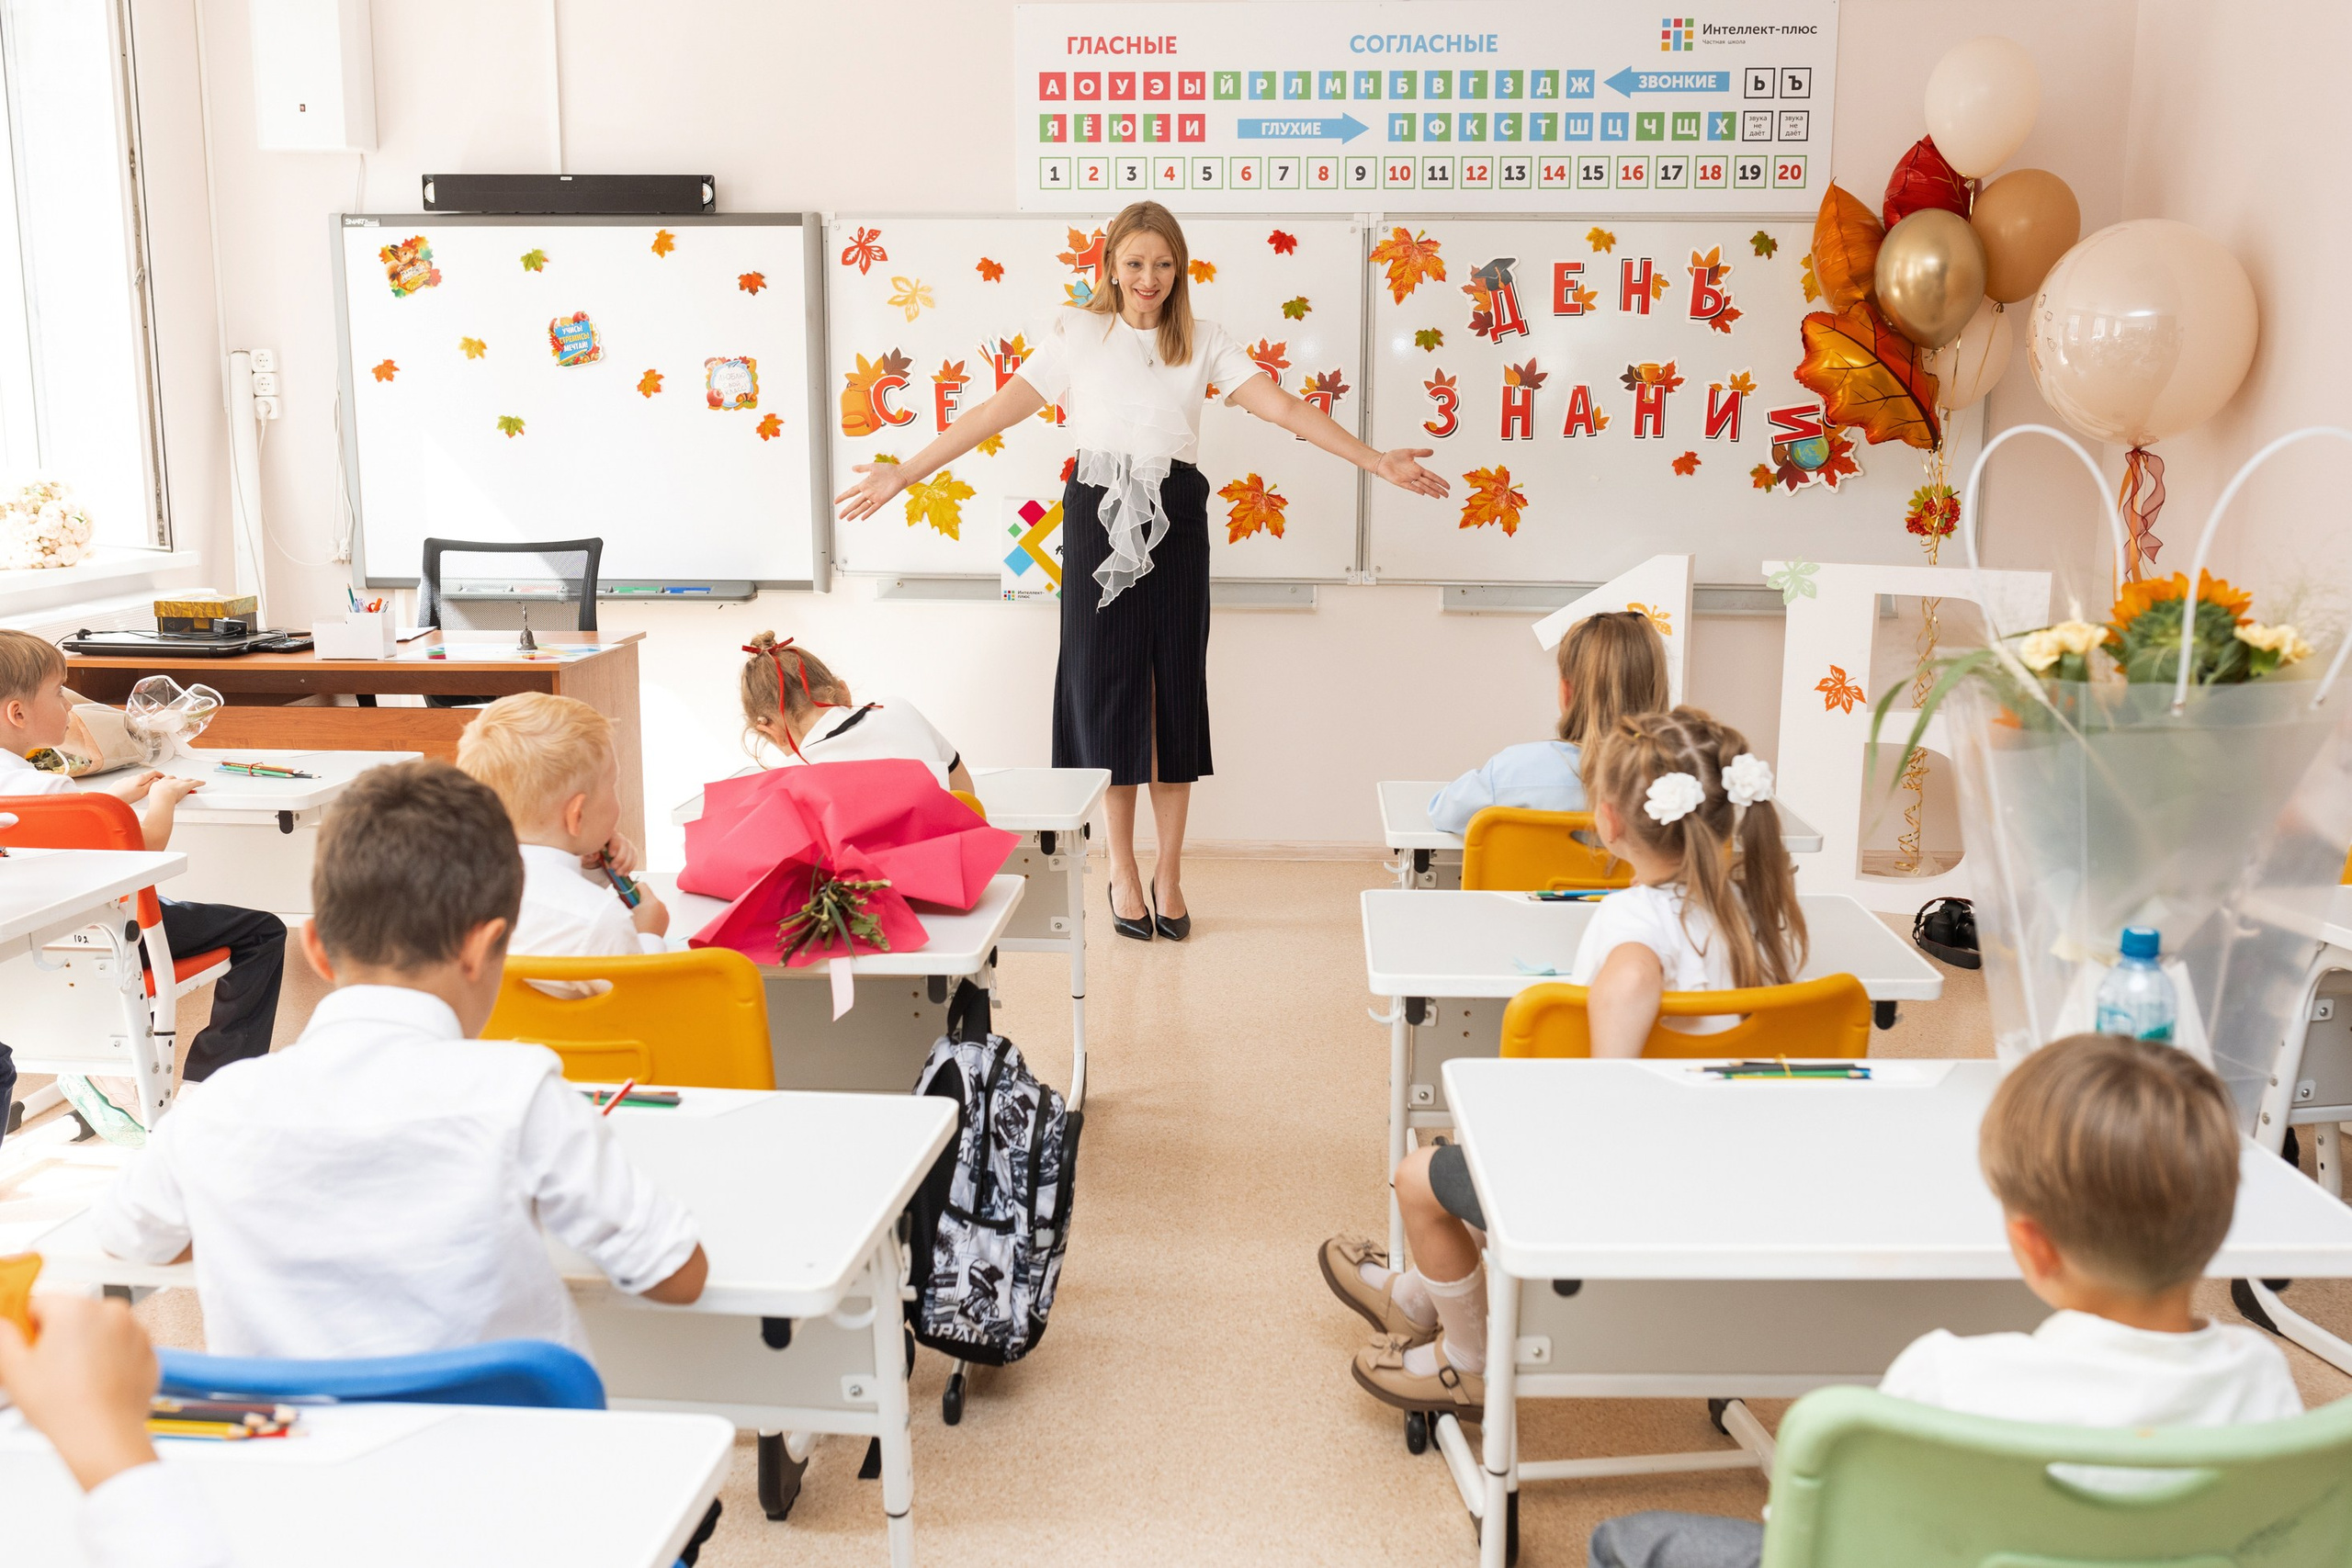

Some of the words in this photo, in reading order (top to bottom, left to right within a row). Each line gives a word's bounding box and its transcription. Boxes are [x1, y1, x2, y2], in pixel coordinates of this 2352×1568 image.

[1702, 23, 1818, 35] Интеллект-плюс
[1068, 35, 1178, 55] ГЛАСНЫЕ
[1350, 34, 1498, 53] СОГЛАСНЫЕ
[1046, 79, 1059, 96] А
[1079, 79, 1095, 96] О
[1115, 79, 1129, 95] У
[1149, 78, 1164, 95] Э
[1184, 78, 1201, 95] Ы
[1220, 74, 1234, 95] Й
[1256, 78, 1268, 95] Р
[1288, 77, 1303, 95] Л
[1325, 77, 1341, 95] М
[1360, 77, 1374, 94] Н
[1396, 77, 1408, 94] Б
[1432, 77, 1444, 94] В
[1468, 77, 1478, 94] Г
[1502, 76, 1514, 94] З
[1536, 76, 1553, 96] Д
[1569, 76, 1590, 94] Ж
[1638, 74, 1716, 89] ЗВОНКИЕ
[1753, 74, 1766, 91] Ь
[1788, 74, 1803, 91] Ъ
[1046, 120, 1058, 137] Я
[1082, 117, 1093, 137] Ё
[1113, 120, 1134, 137] Ю
[1152, 120, 1162, 136] Е
[1185, 120, 1199, 136] И
[1261, 121, 1321, 136] ГЛУХИЕ
[1395, 119, 1408, 136] П
[1428, 118, 1446, 136] Ф
[1465, 119, 1478, 135] К
[1499, 118, 1514, 136] С
[1537, 118, 1550, 135] Т
[1569, 118, 1589, 135] Ш
[1608, 118, 1623, 138] Ц
[1644, 118, 1657, 134] Ч
[1677, 118, 1697, 137] Щ
[1715, 118, 1728, 134] Х
[1050, 166, 1060, 181] 1
[1089, 165, 1099, 181] 2
[1126, 166, 1137, 182] 3
[1163, 165, 1176, 181] 4
[1202, 165, 1213, 182] 5
[1240, 165, 1252, 182] 6
[1278, 165, 1289, 181] 7
[1317, 165, 1329, 182] 8
[1354, 165, 1366, 181] 9
[1388, 165, 1411, 181] 10
[1428, 165, 1449, 181] 11
[1465, 164, 1487, 181] 12
[1504, 165, 1526, 181] 13
[1544, 165, 1566, 181] 14
[1582, 164, 1604, 181] 15
[1622, 164, 1645, 181] 16
[1660, 164, 1683, 181] 17
[1699, 164, 1722, 181] 18
[1738, 164, 1761, 181] 19
[1777, 164, 1803, 181] 20
[1488, 257, 1726, 344] ДЕНЬ
[561, 325, 583, 335] УЧИСЬ!
[563, 341, 589, 352] МЕЧТАЙ!
[74, 934, 89, 944] 102
